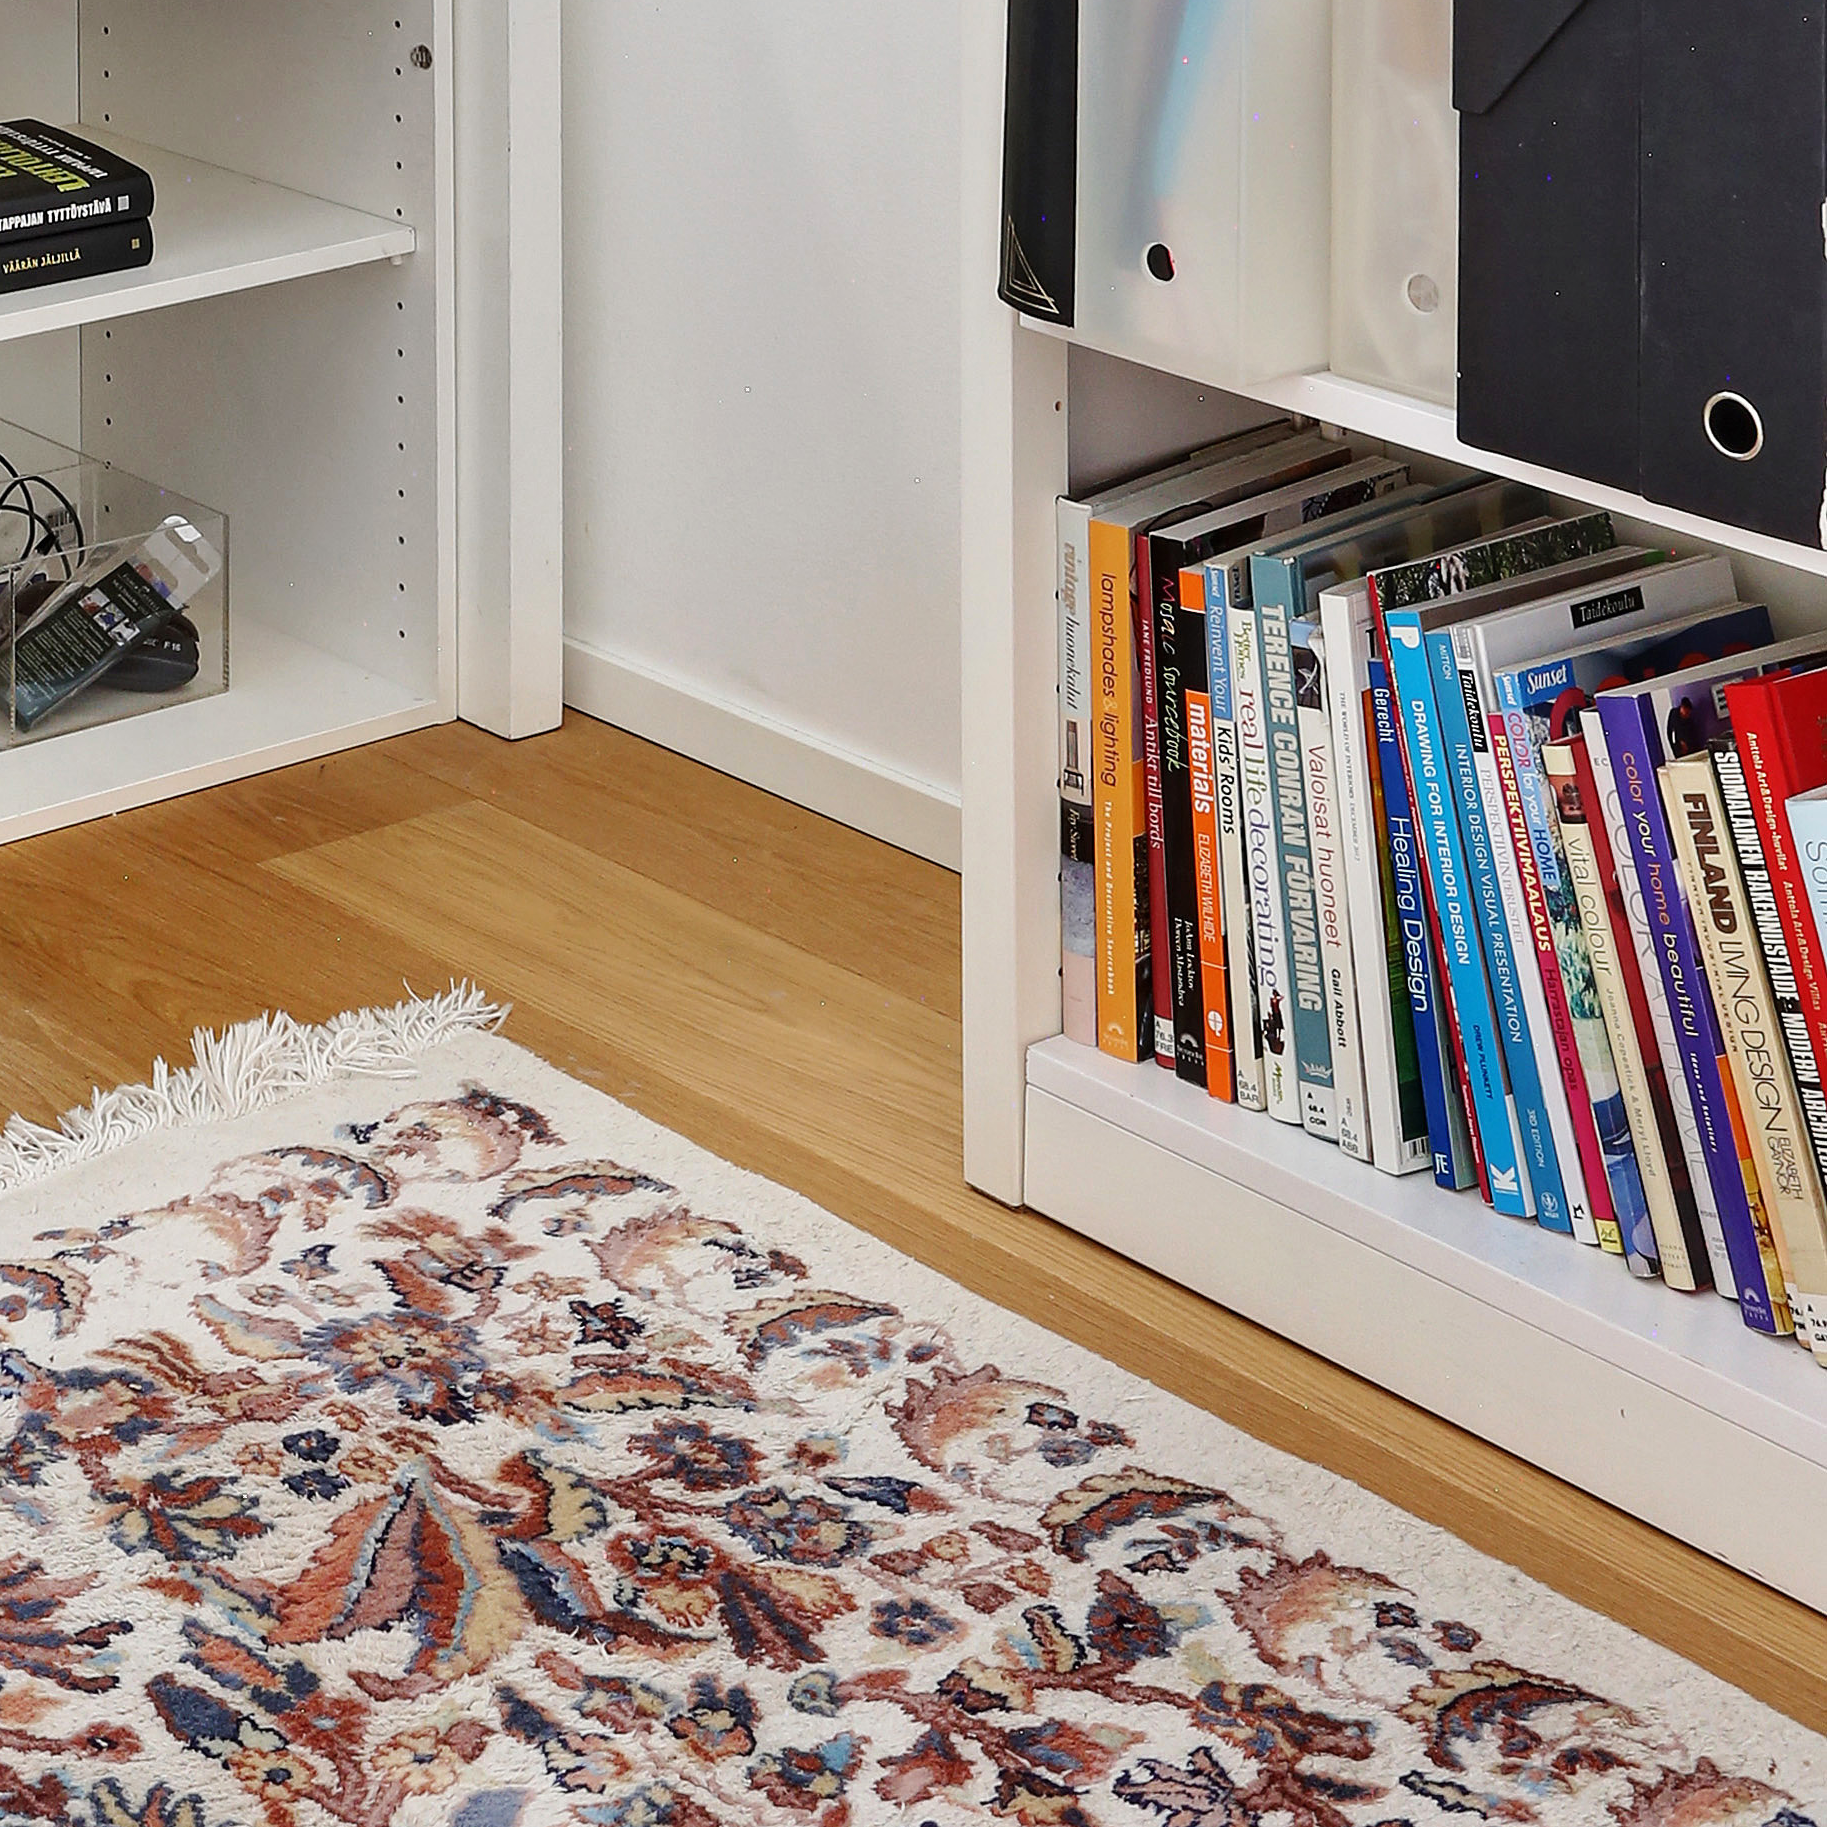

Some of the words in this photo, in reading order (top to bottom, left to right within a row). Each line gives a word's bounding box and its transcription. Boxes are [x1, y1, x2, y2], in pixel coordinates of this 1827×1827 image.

[1, 258, 40, 275] VÄÄRÄN
[39, 247, 82, 267] JÄLJILLÄ
[46, 197, 112, 224] TYTTÖYSTÄVÄ
[1099, 573, 1119, 698] lampshades
[1262, 604, 1296, 726] TERENCE
[1099, 712, 1121, 788] lighting
[1188, 703, 1215, 815] materials
[1373, 687, 1396, 743] Gerecht
[1273, 731, 1307, 847] CONRAN
[1307, 744, 1333, 838] Valoisat
[1455, 742, 1479, 809] INTERIOR
[1389, 817, 1421, 911] Healing
[1411, 700, 1437, 779] DRAWING
[1431, 821, 1457, 898] INTERIOR
[1444, 902, 1471, 966] DESIGN
[1467, 811, 1489, 869] DESIGN
[1494, 734, 1553, 952] PERSPEKTIIVIMAALAUS
[1246, 807, 1281, 988] decorating
[1285, 854, 1323, 1012] FÖRVARING
[1317, 846, 1341, 949] huoneet
[1478, 872, 1500, 927] VISUAL
[1714, 751, 1763, 866] SUOMALAINEN
[1743, 869, 1800, 1001] RAKENNUSTAIDE
[1782, 1011, 1821, 1084] MODERN
[1402, 919, 1431, 1012] Design
[1488, 931, 1522, 1043] PRESENTATION
[1662, 932, 1699, 1037] beautiful
[1681, 792, 1737, 934] FINLAND
[1744, 1031, 1787, 1132] DESIGN
